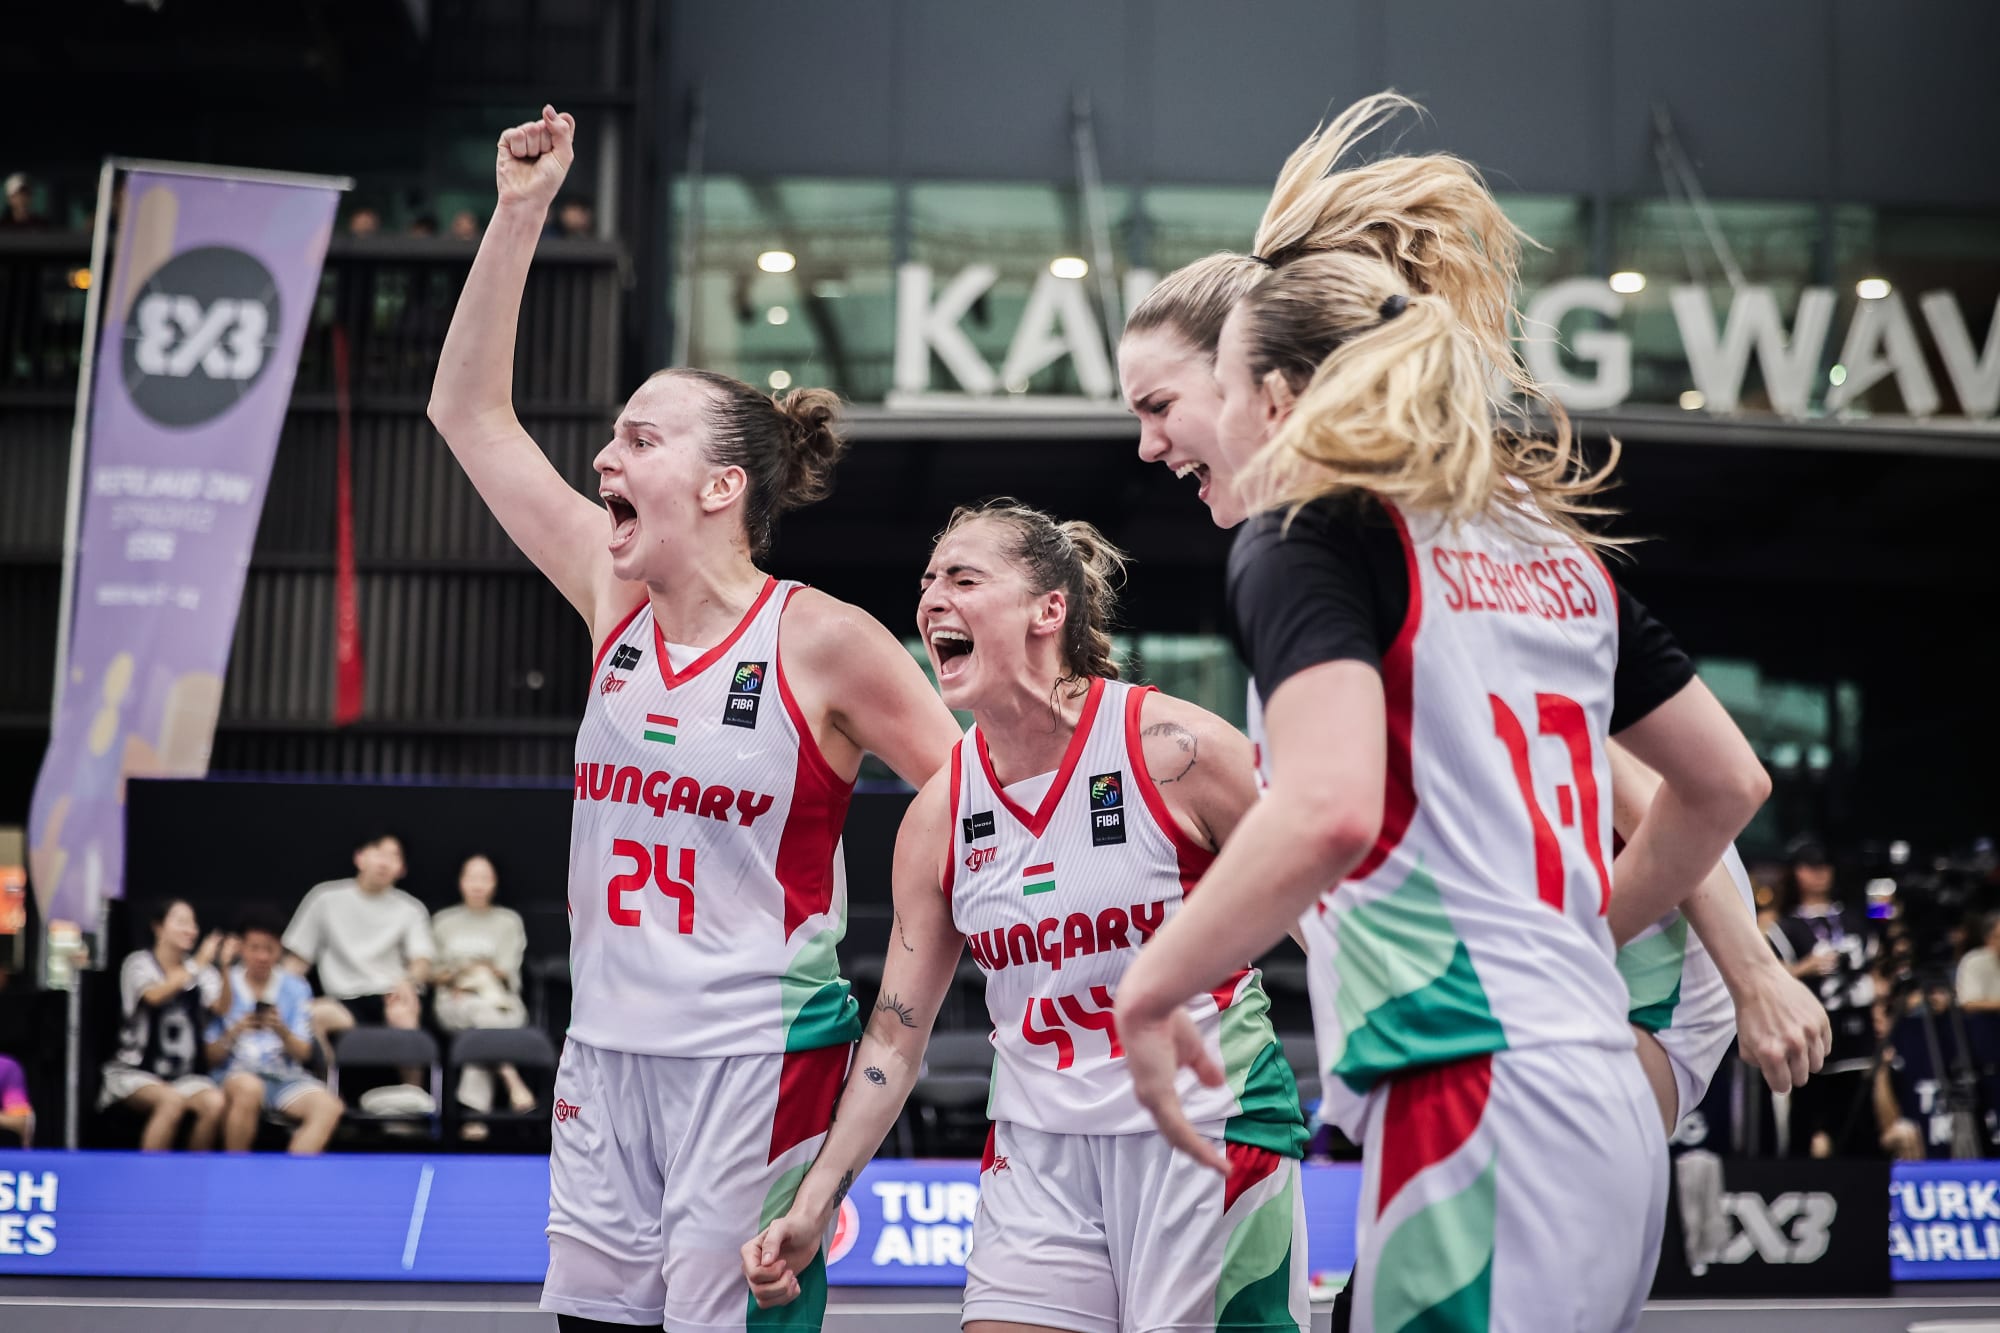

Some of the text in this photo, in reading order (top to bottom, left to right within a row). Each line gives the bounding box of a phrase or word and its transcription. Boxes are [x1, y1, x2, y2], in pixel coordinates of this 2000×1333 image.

[730, 698, 754, 711] FIBA
[574, 762, 774, 827] HUNGARY
[1096, 813, 1119, 828] FIBA
[607, 838, 696, 934] 24
[968, 901, 1165, 971] HUNGARY
